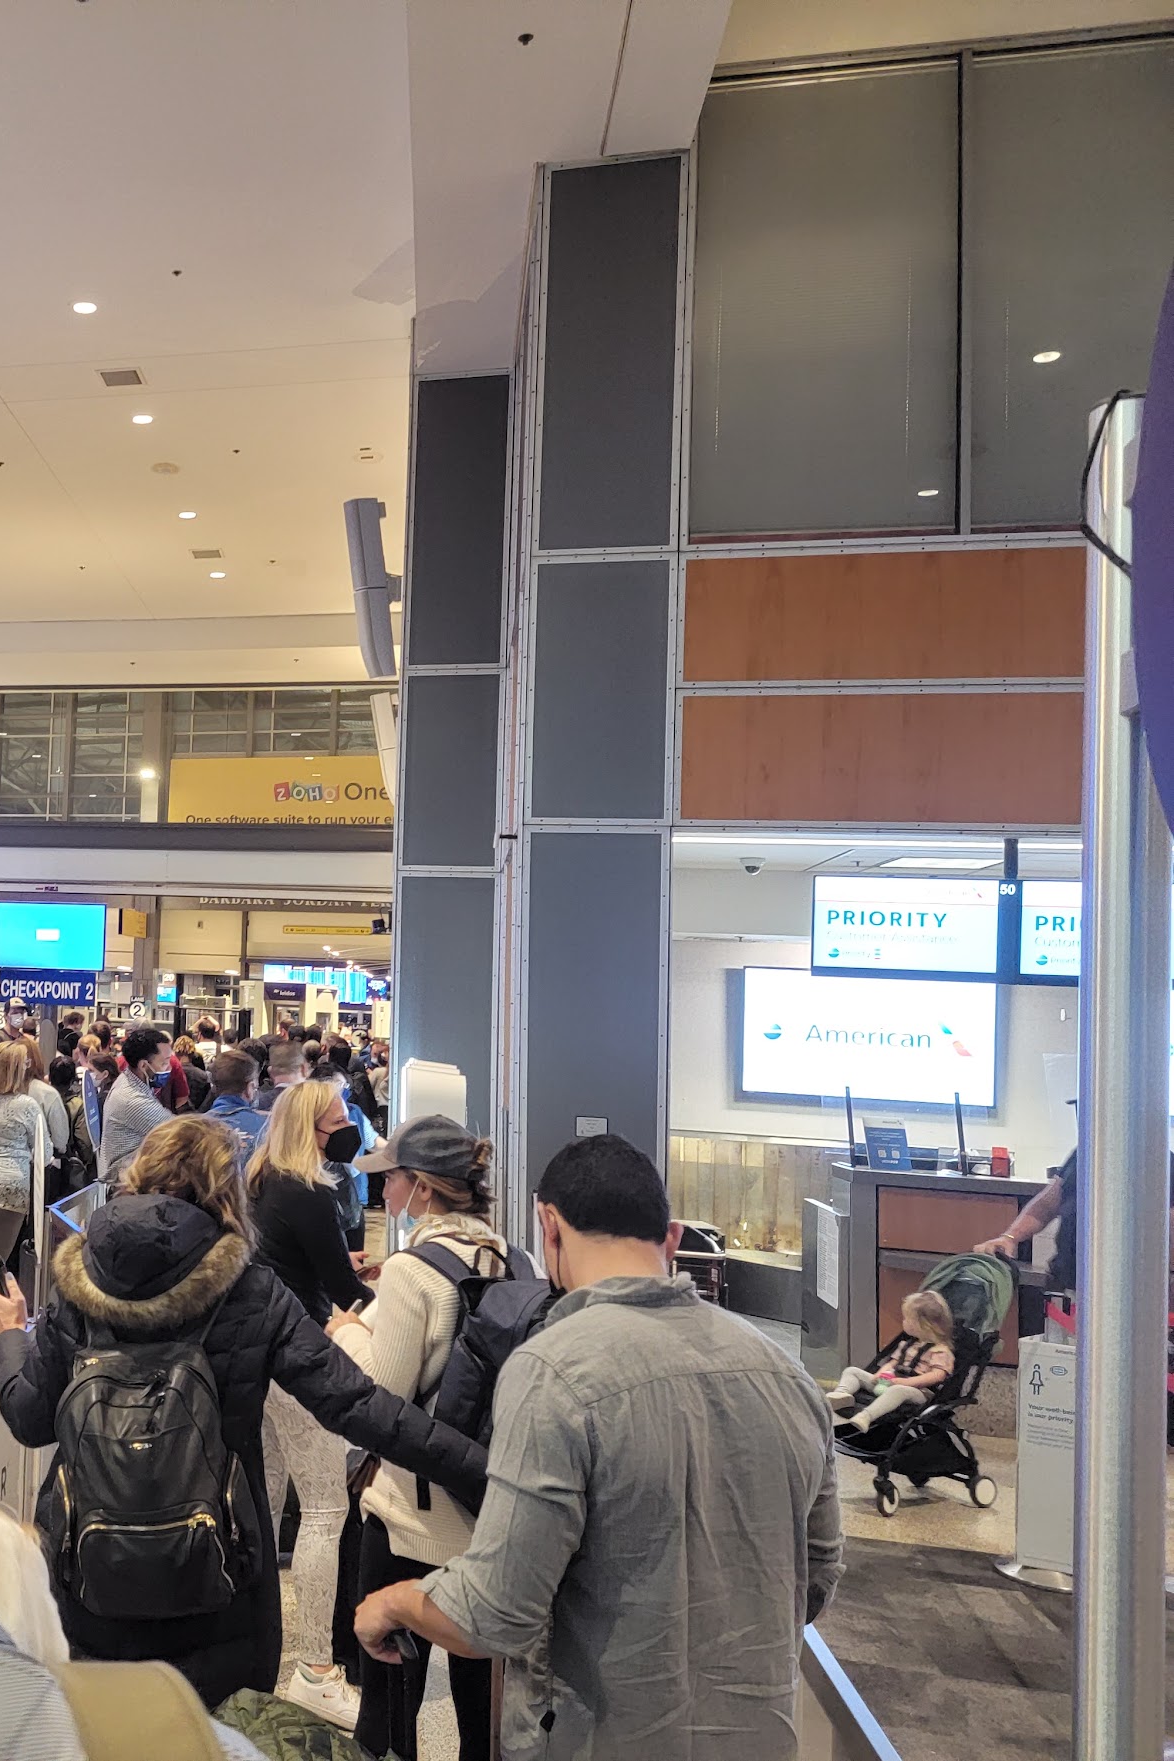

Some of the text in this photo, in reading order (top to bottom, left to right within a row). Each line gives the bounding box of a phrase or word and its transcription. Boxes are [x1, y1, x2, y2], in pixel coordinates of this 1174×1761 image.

[186, 814, 213, 824] One
[215, 814, 269, 824] software
[273, 814, 304, 825] suite
[307, 815, 320, 825] to
[325, 816, 346, 825] run
[350, 816, 380, 825] your
[999, 883, 1016, 896] 50
[827, 909, 947, 928] PRIORITY
[0, 980, 94, 1000] CHECKPOINT 2
[133, 1005, 141, 1016] 2
[805, 1024, 931, 1049] American
